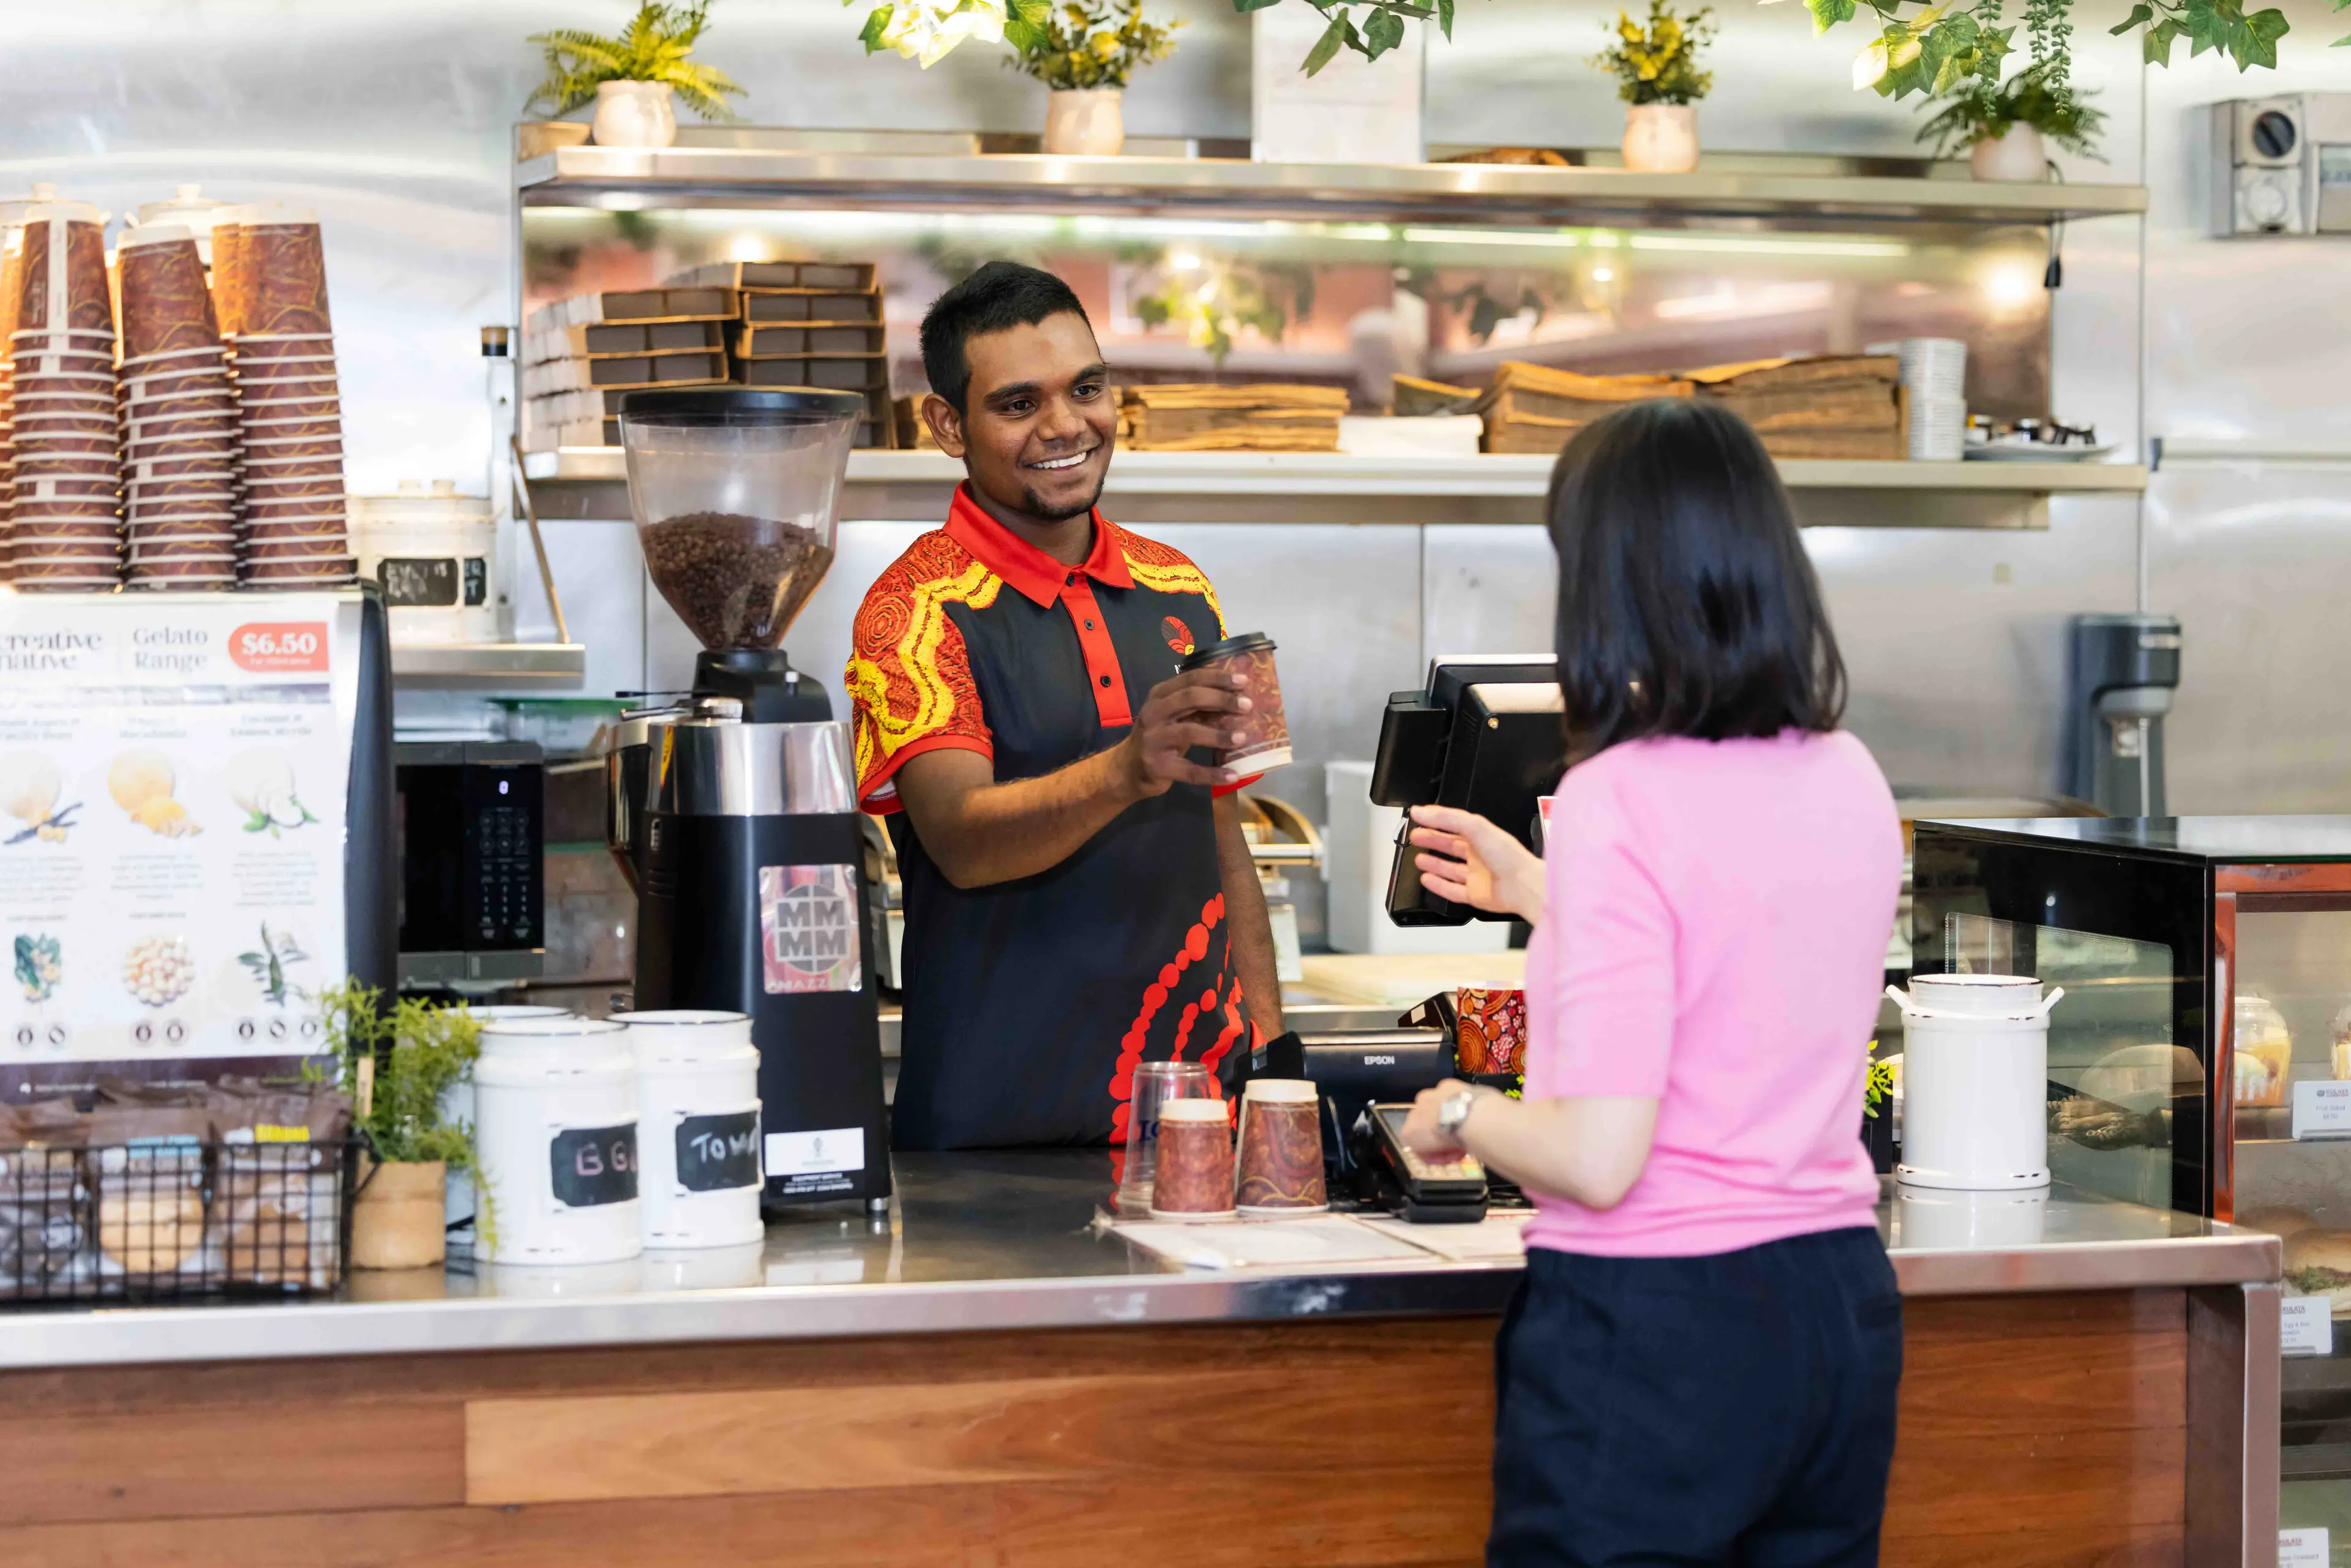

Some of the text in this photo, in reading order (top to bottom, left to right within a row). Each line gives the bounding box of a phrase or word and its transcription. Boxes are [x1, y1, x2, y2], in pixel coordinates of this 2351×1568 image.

[133, 626, 208, 646] Gelato
[241, 632, 318, 656] $6.50
[134, 651, 208, 672] Range
[1364, 1056, 1395, 1065] EPSON
